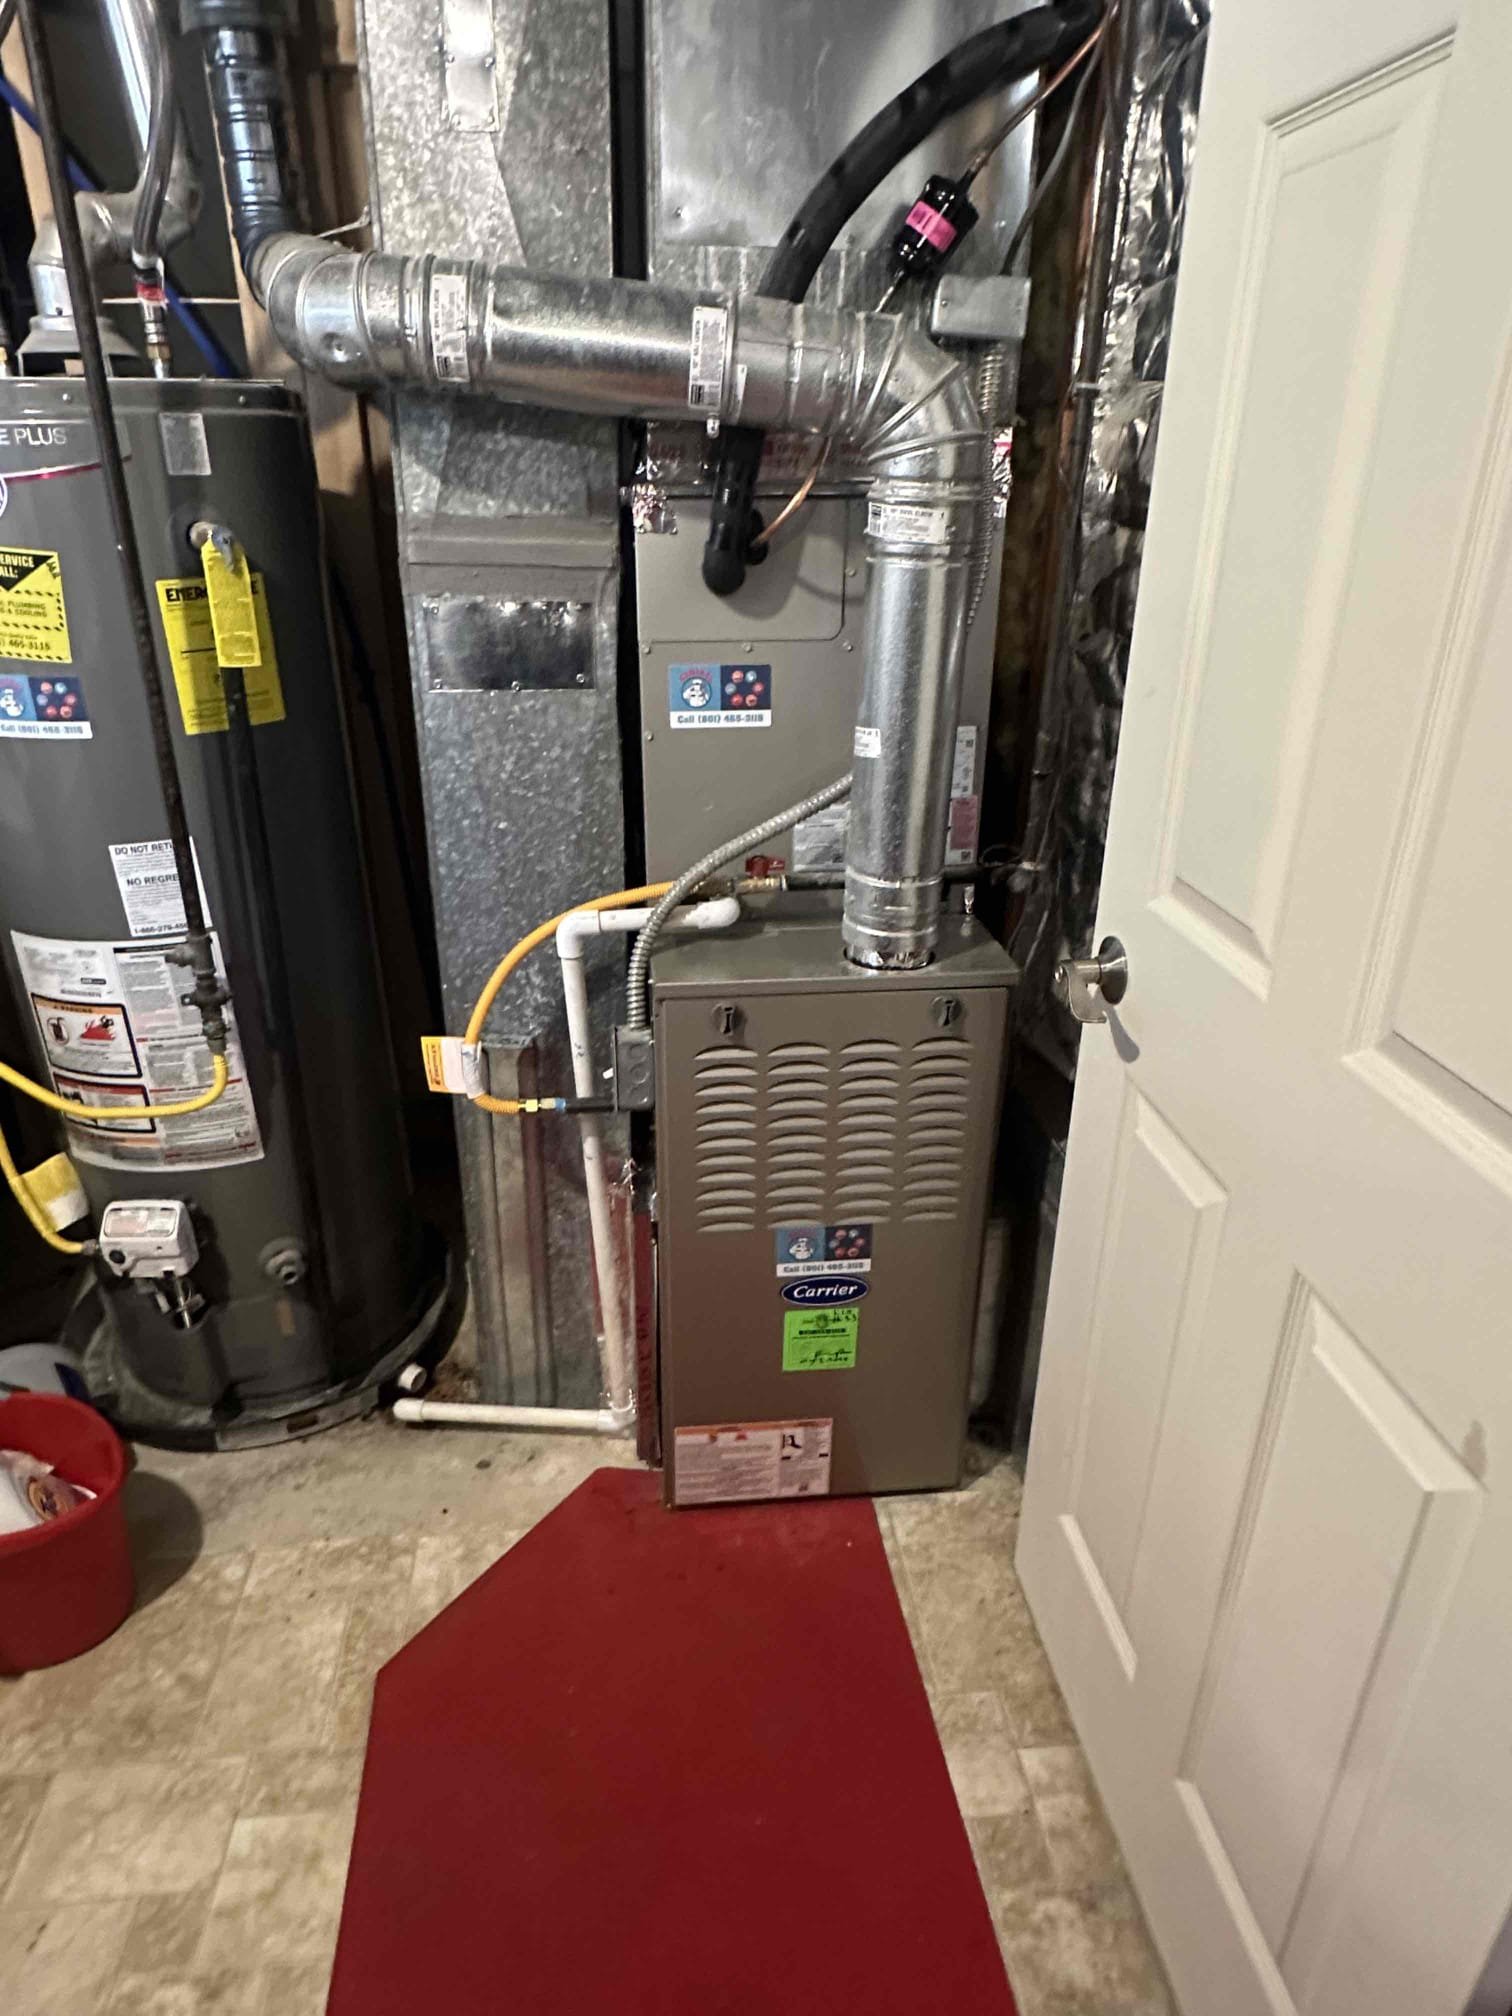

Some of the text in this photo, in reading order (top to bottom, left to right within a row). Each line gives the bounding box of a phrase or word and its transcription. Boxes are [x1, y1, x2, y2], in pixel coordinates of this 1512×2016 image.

[14, 427, 67, 445] PLUS
[0, 551, 35, 567] ERVICE
[0, 564, 18, 578] ALL:
[677, 714, 695, 723] Call
[698, 713, 721, 724] (801)
[114, 847, 128, 855] DO
[130, 844, 149, 853] NOT
[127, 874, 180, 886] NO REGRE
[793, 1284, 858, 1298] Carrier
